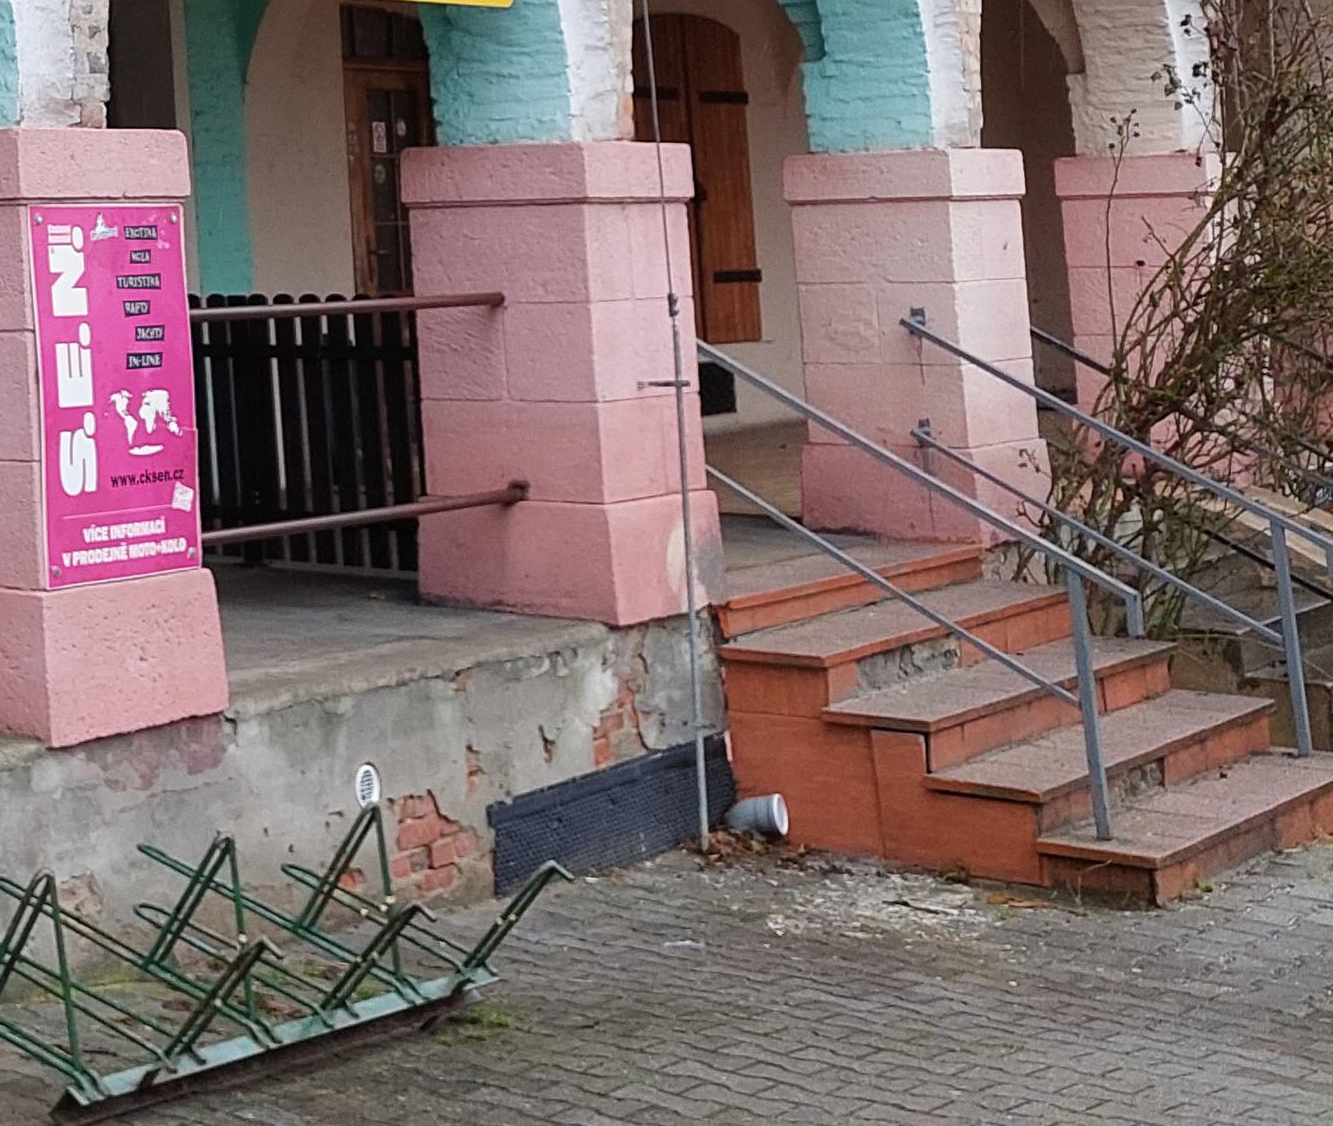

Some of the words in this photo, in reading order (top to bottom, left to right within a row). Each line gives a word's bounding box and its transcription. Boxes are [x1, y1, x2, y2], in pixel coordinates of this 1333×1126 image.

[117, 275, 161, 289] TURISTIKA
[128, 353, 162, 369] IN-LINE
[110, 469, 184, 488] www.cksen.cz
[82, 524, 109, 543] VÍCE
[110, 516, 166, 539] INFORMACÍ
[62, 552, 71, 567] V
[72, 542, 128, 566] PRODEJNĚ
[129, 537, 187, 559] MOTO+KOLO
